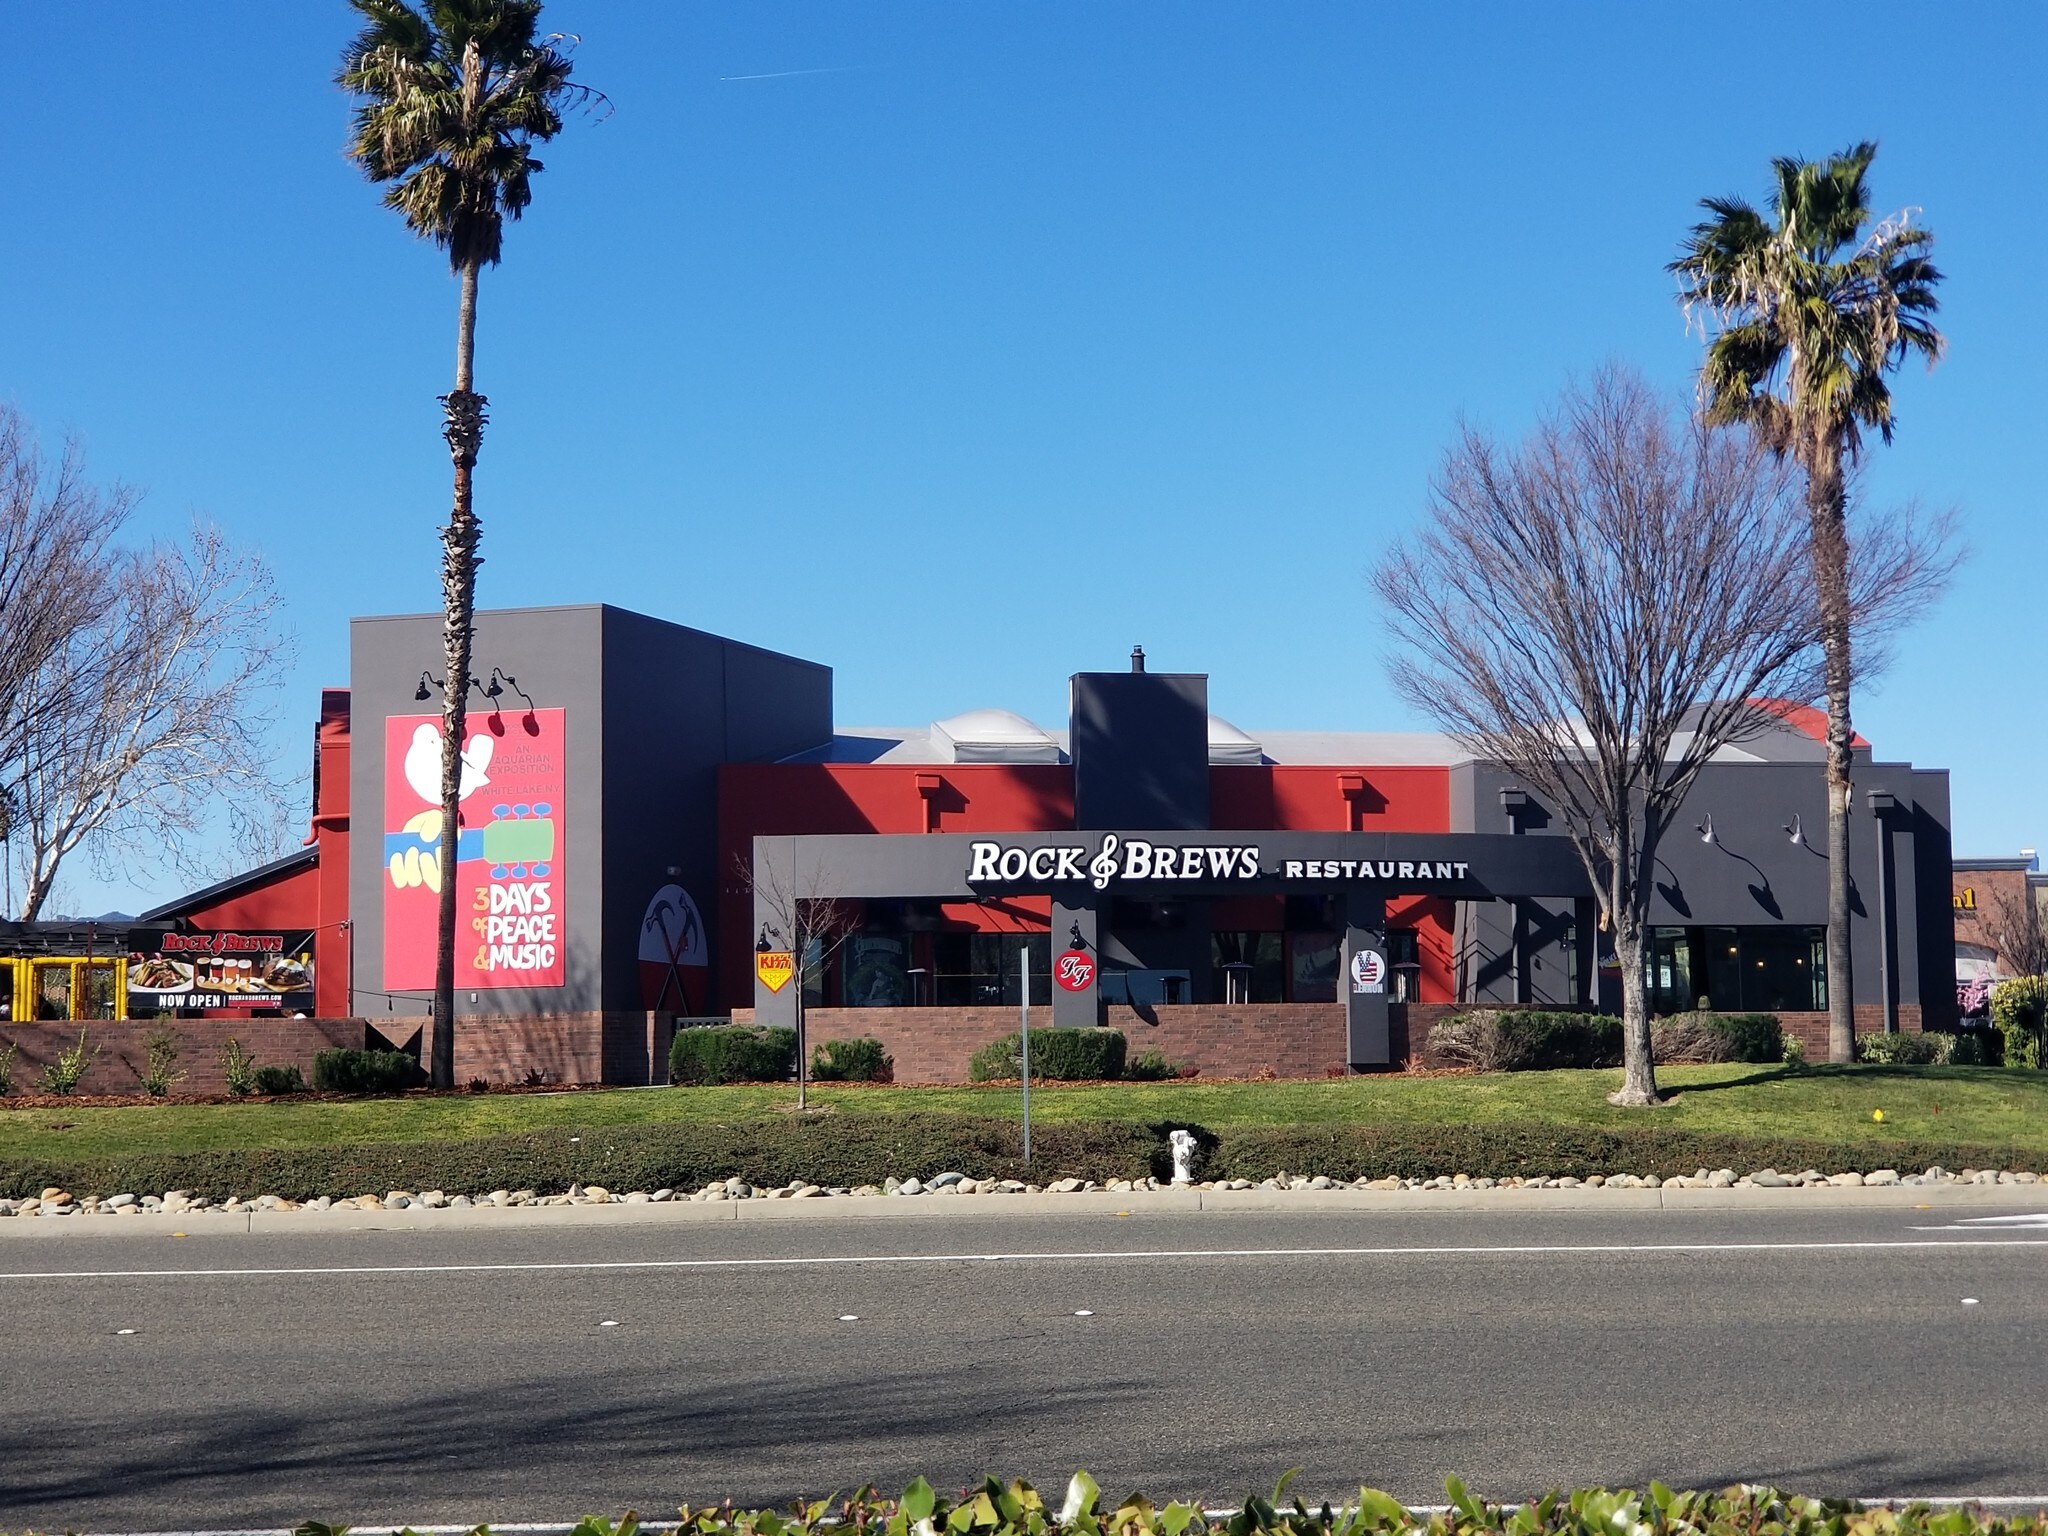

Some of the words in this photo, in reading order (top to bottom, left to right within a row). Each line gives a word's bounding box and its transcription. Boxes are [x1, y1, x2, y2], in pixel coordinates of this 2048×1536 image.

[515, 745, 530, 754] AN
[494, 754, 550, 765] AQUARIAN
[489, 763, 554, 775] EXPOSITION
[481, 785, 513, 796] WHITE
[968, 843, 1086, 881] ROCK
[1121, 841, 1260, 879] BREWS
[1286, 860, 1469, 879] RESTAURANT
[472, 887, 490, 911] 3
[489, 882, 552, 915] DAYS
[487, 914, 557, 944] PEACE
[161, 933, 212, 952] ROCK
[222, 933, 283, 952] BREWS
[473, 944, 490, 970] &
[489, 943, 556, 972] MUSIC
[760, 955, 791, 969] KISS
[158, 994, 186, 1008] NOW
[189, 994, 220, 1007] OPEN
